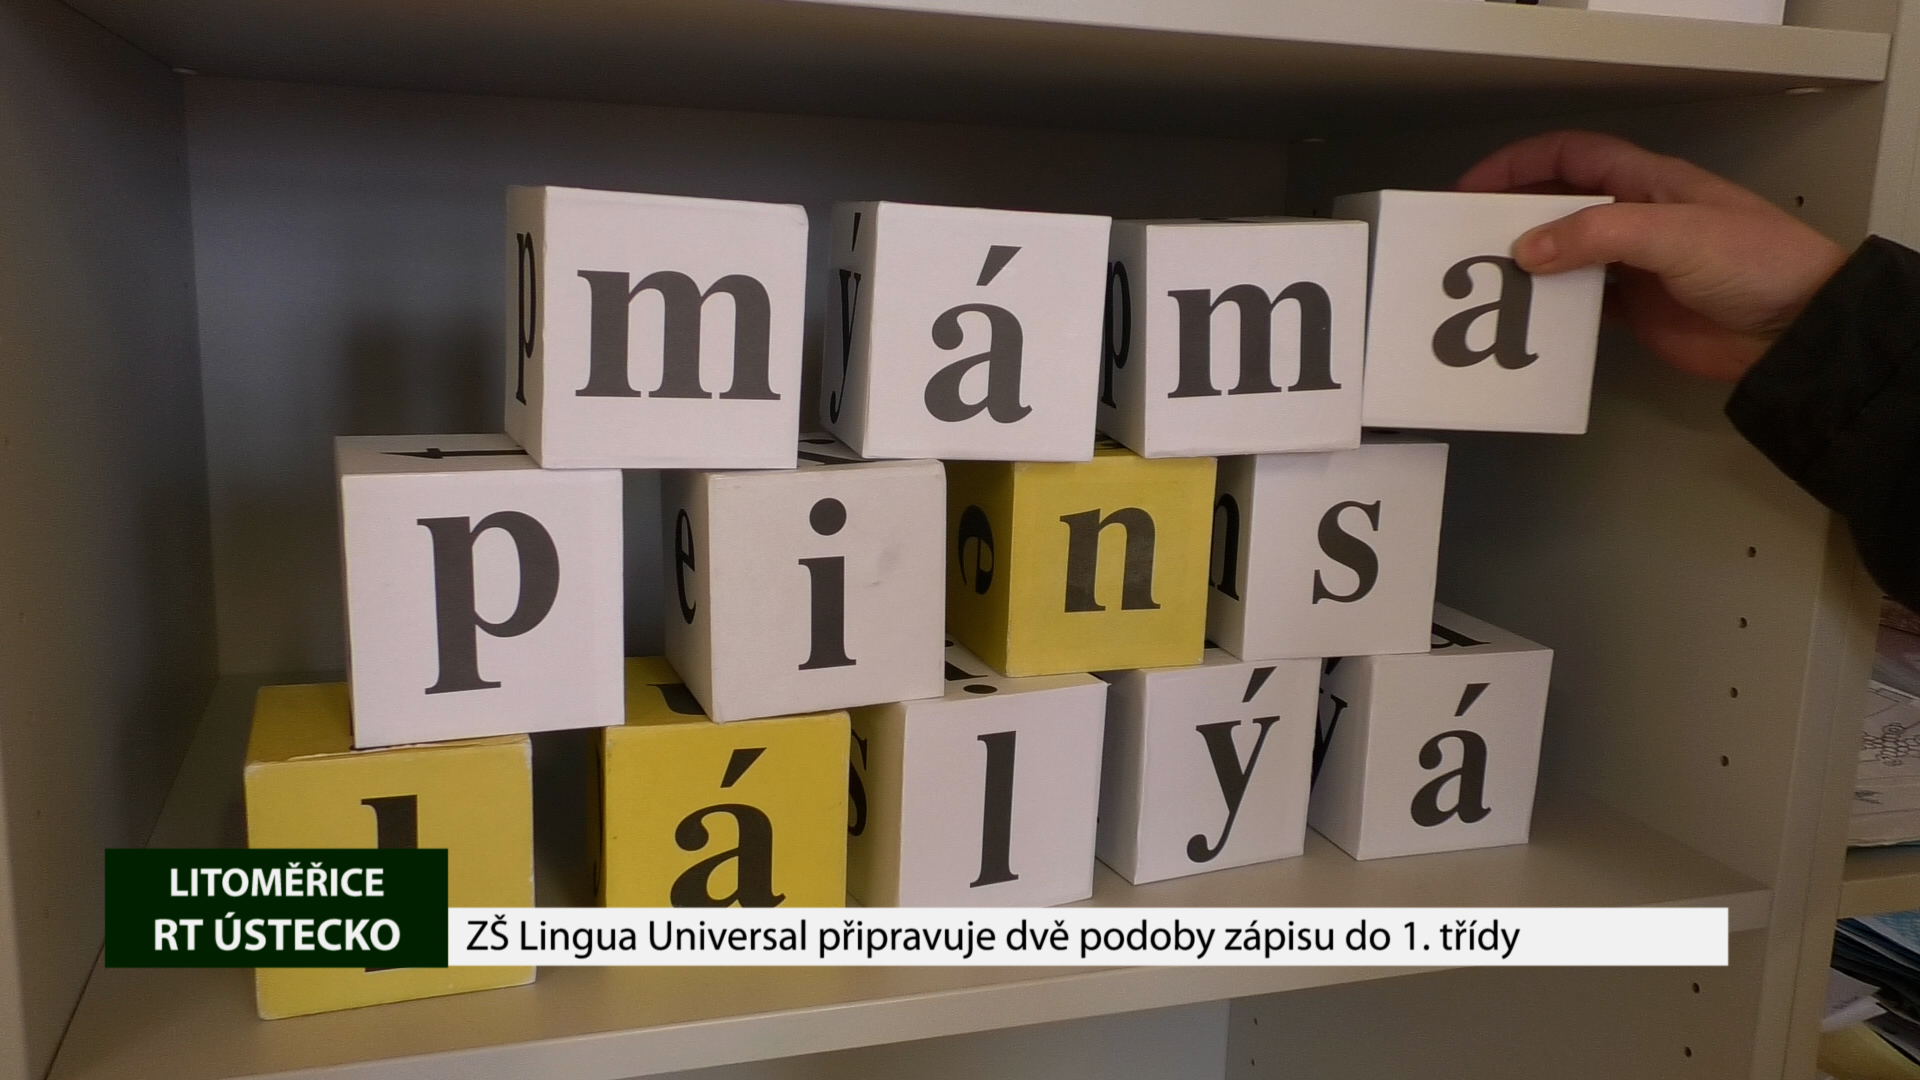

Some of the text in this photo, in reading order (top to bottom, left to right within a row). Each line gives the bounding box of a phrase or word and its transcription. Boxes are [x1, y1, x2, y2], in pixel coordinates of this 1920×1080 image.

[516, 232, 536, 406] p
[575, 245, 1539, 424] m á m a
[830, 212, 862, 424] ý
[416, 497, 1381, 695] p i n s
[675, 508, 696, 625] e
[669, 747, 786, 907] á
[1186, 666, 1281, 864] ý
[1410, 682, 1492, 828] á
